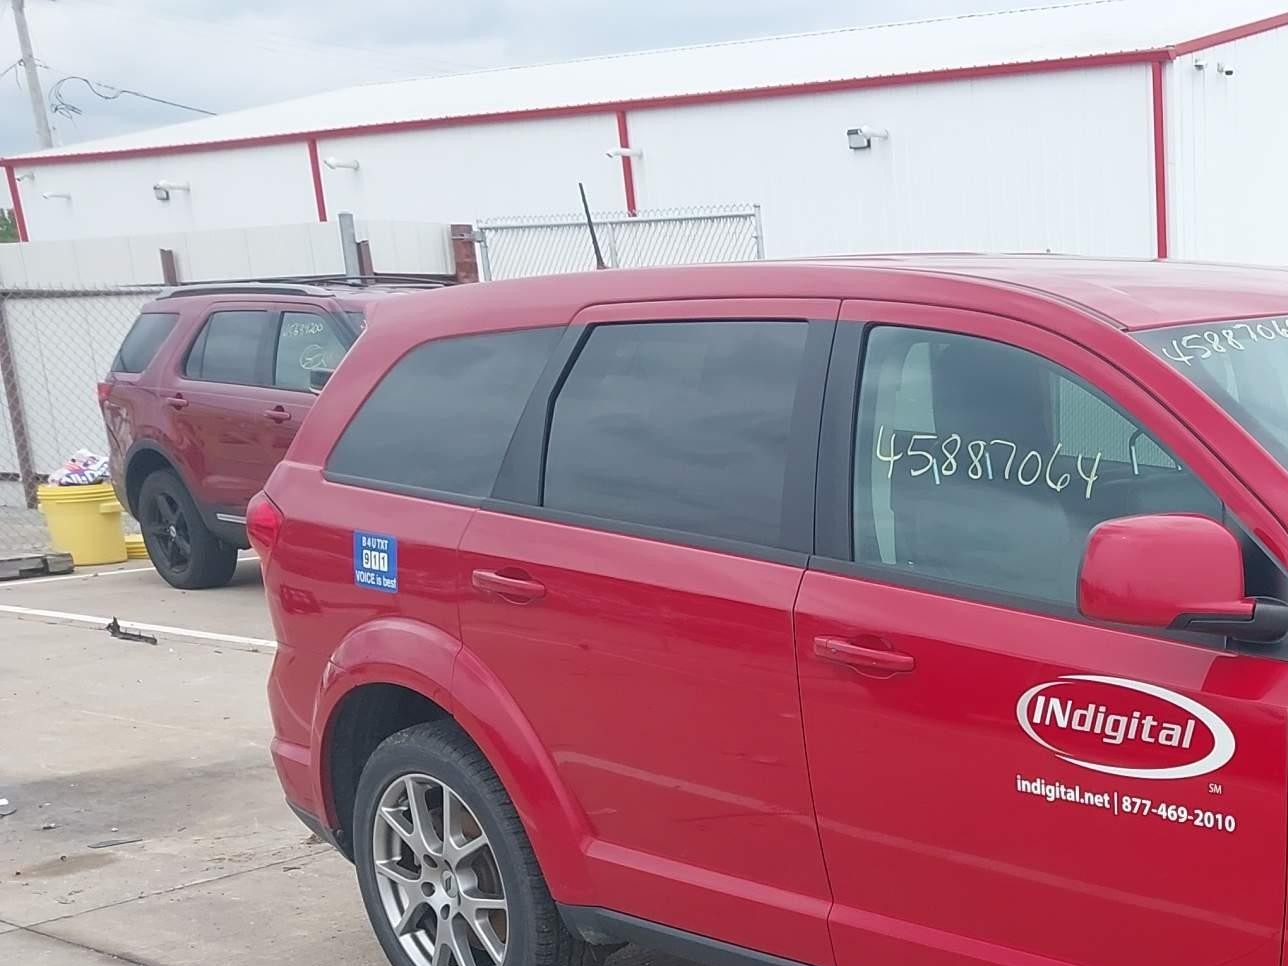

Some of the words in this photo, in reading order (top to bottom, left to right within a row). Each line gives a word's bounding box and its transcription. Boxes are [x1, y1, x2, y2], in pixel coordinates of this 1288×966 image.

[876, 425, 1102, 499] 45887064
[377, 539, 389, 550] TXT
[364, 551, 387, 569] 911
[356, 570, 375, 585] VOICE
[376, 574, 382, 586] is
[383, 575, 397, 588] best
[1033, 695, 1196, 749] INdigital
[1208, 783, 1222, 795] SM
[1016, 774, 1110, 809] indigital.net
[1121, 795, 1236, 832] 877-469-2010
